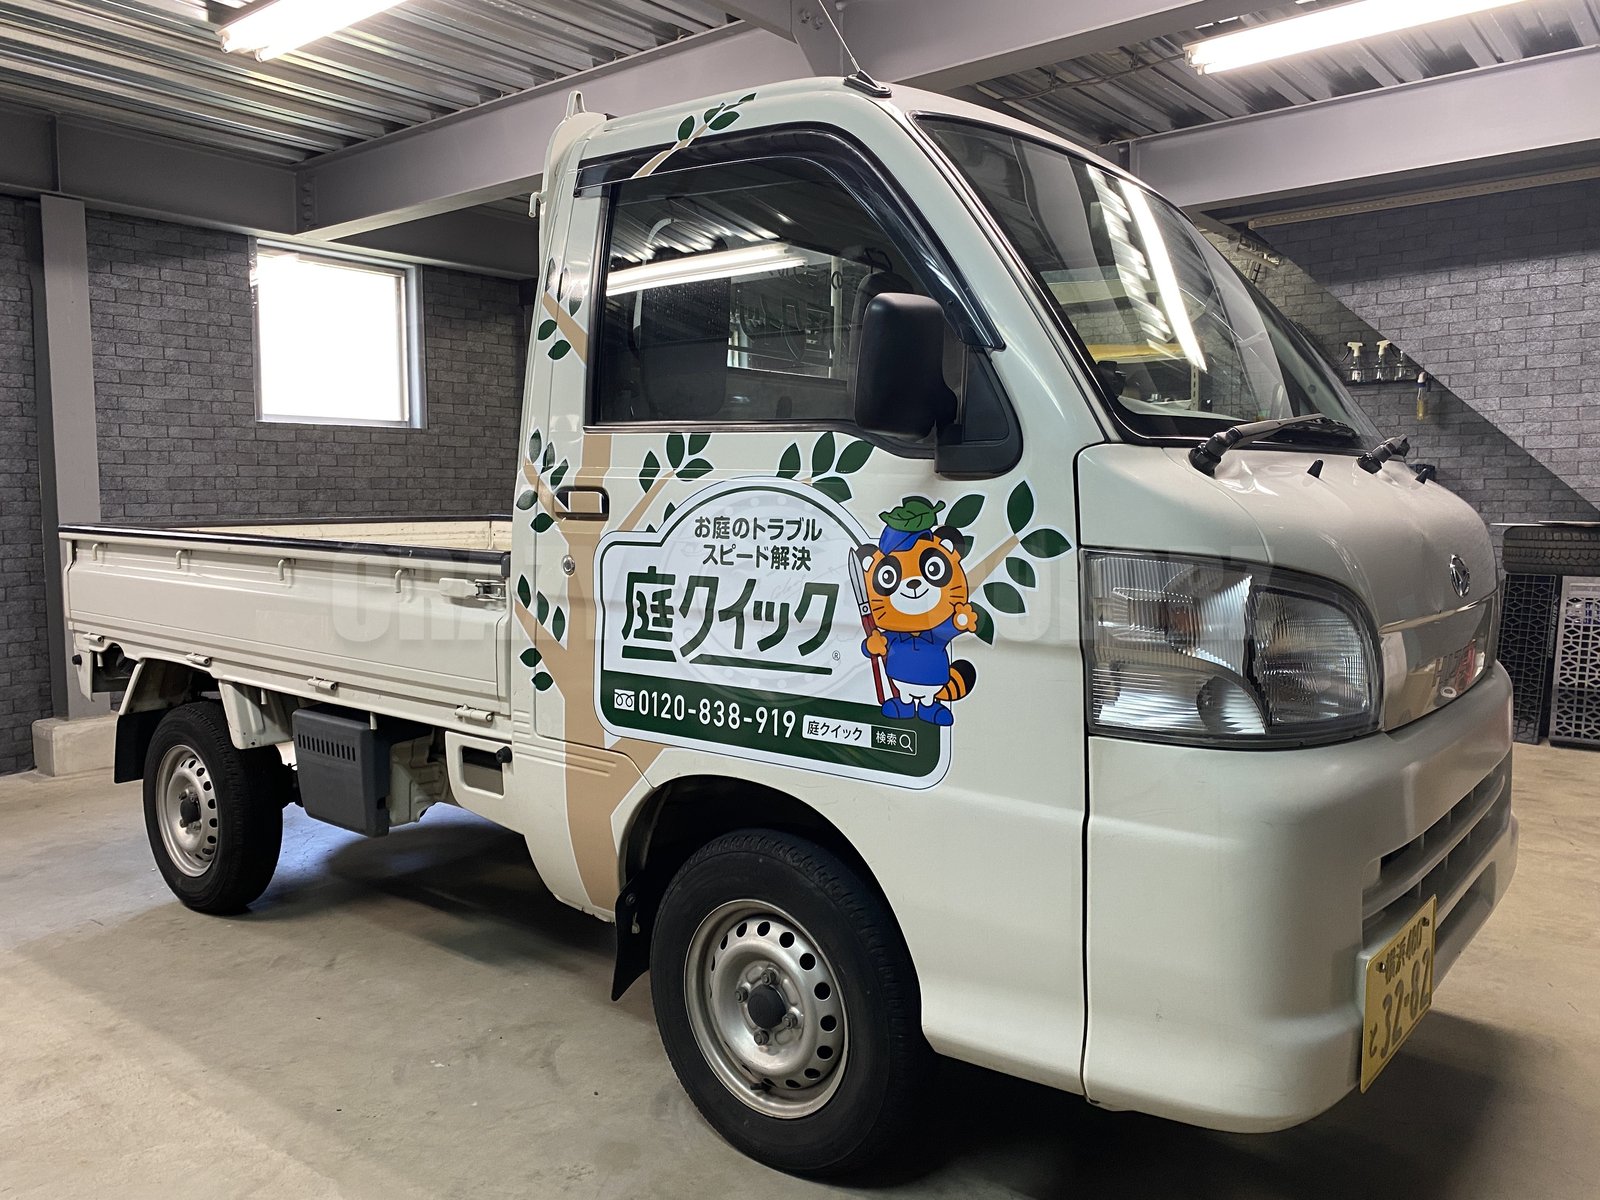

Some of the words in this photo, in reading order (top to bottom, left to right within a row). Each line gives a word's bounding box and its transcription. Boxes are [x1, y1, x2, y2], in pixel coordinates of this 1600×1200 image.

[694, 515, 823, 541] お庭のトラブル
[702, 543, 812, 571] スピード解決
[621, 566, 840, 663] 庭クイック
[638, 689, 796, 739] 0120-838-919
[807, 720, 863, 741] 庭クイック
[876, 730, 897, 746] 検索
[1380, 947, 1431, 1059] 32-82
